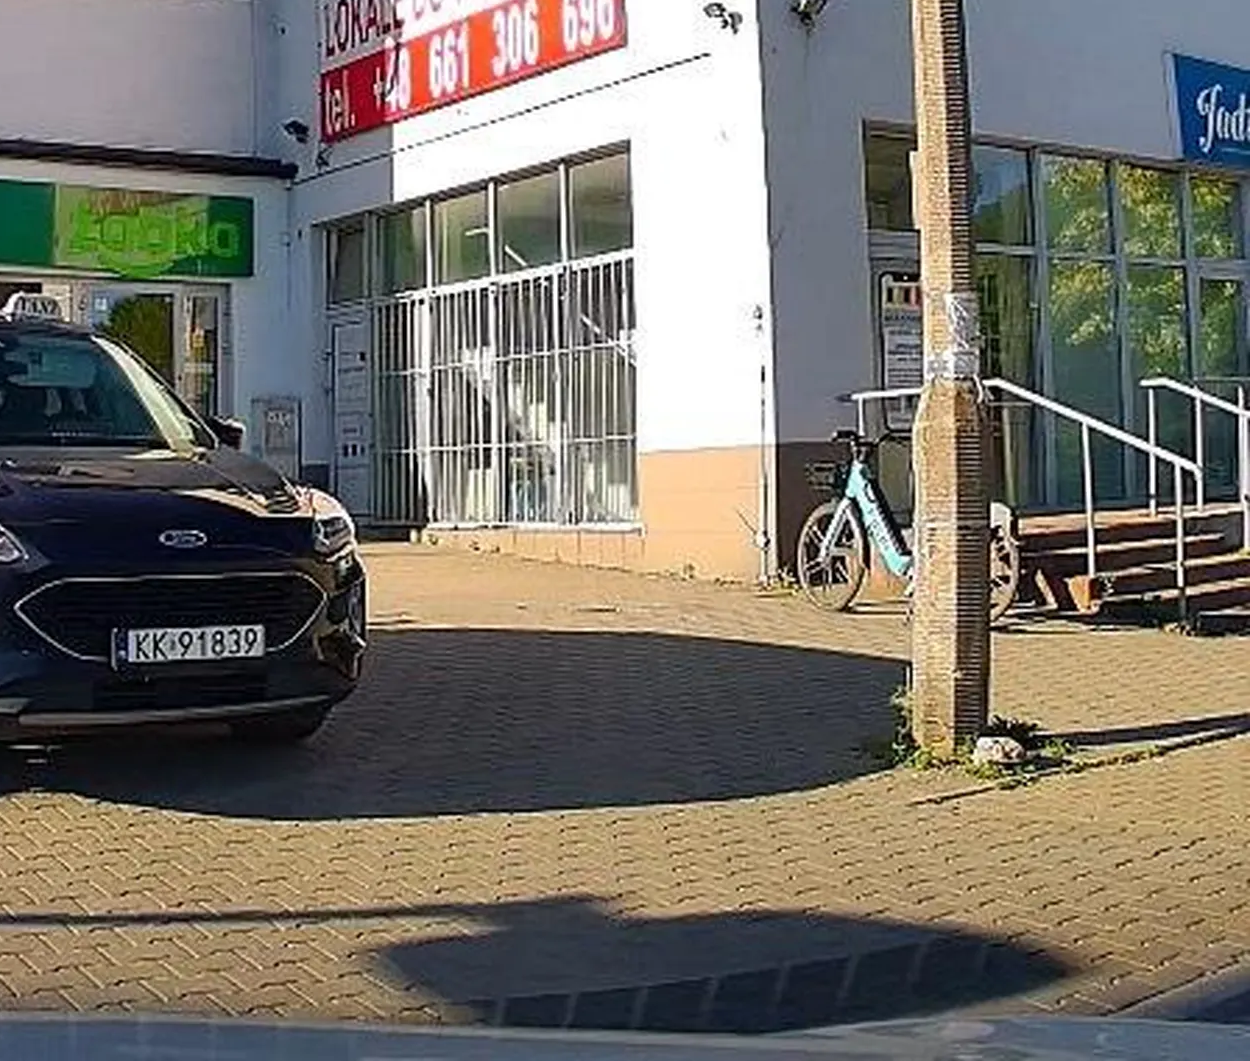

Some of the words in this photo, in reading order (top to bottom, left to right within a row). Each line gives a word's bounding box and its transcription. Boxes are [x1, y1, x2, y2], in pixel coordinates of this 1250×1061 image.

[324, 70, 356, 134] tel.
[428, 20, 472, 99] 661
[135, 631, 168, 660] KK
[178, 628, 257, 657] 91839
